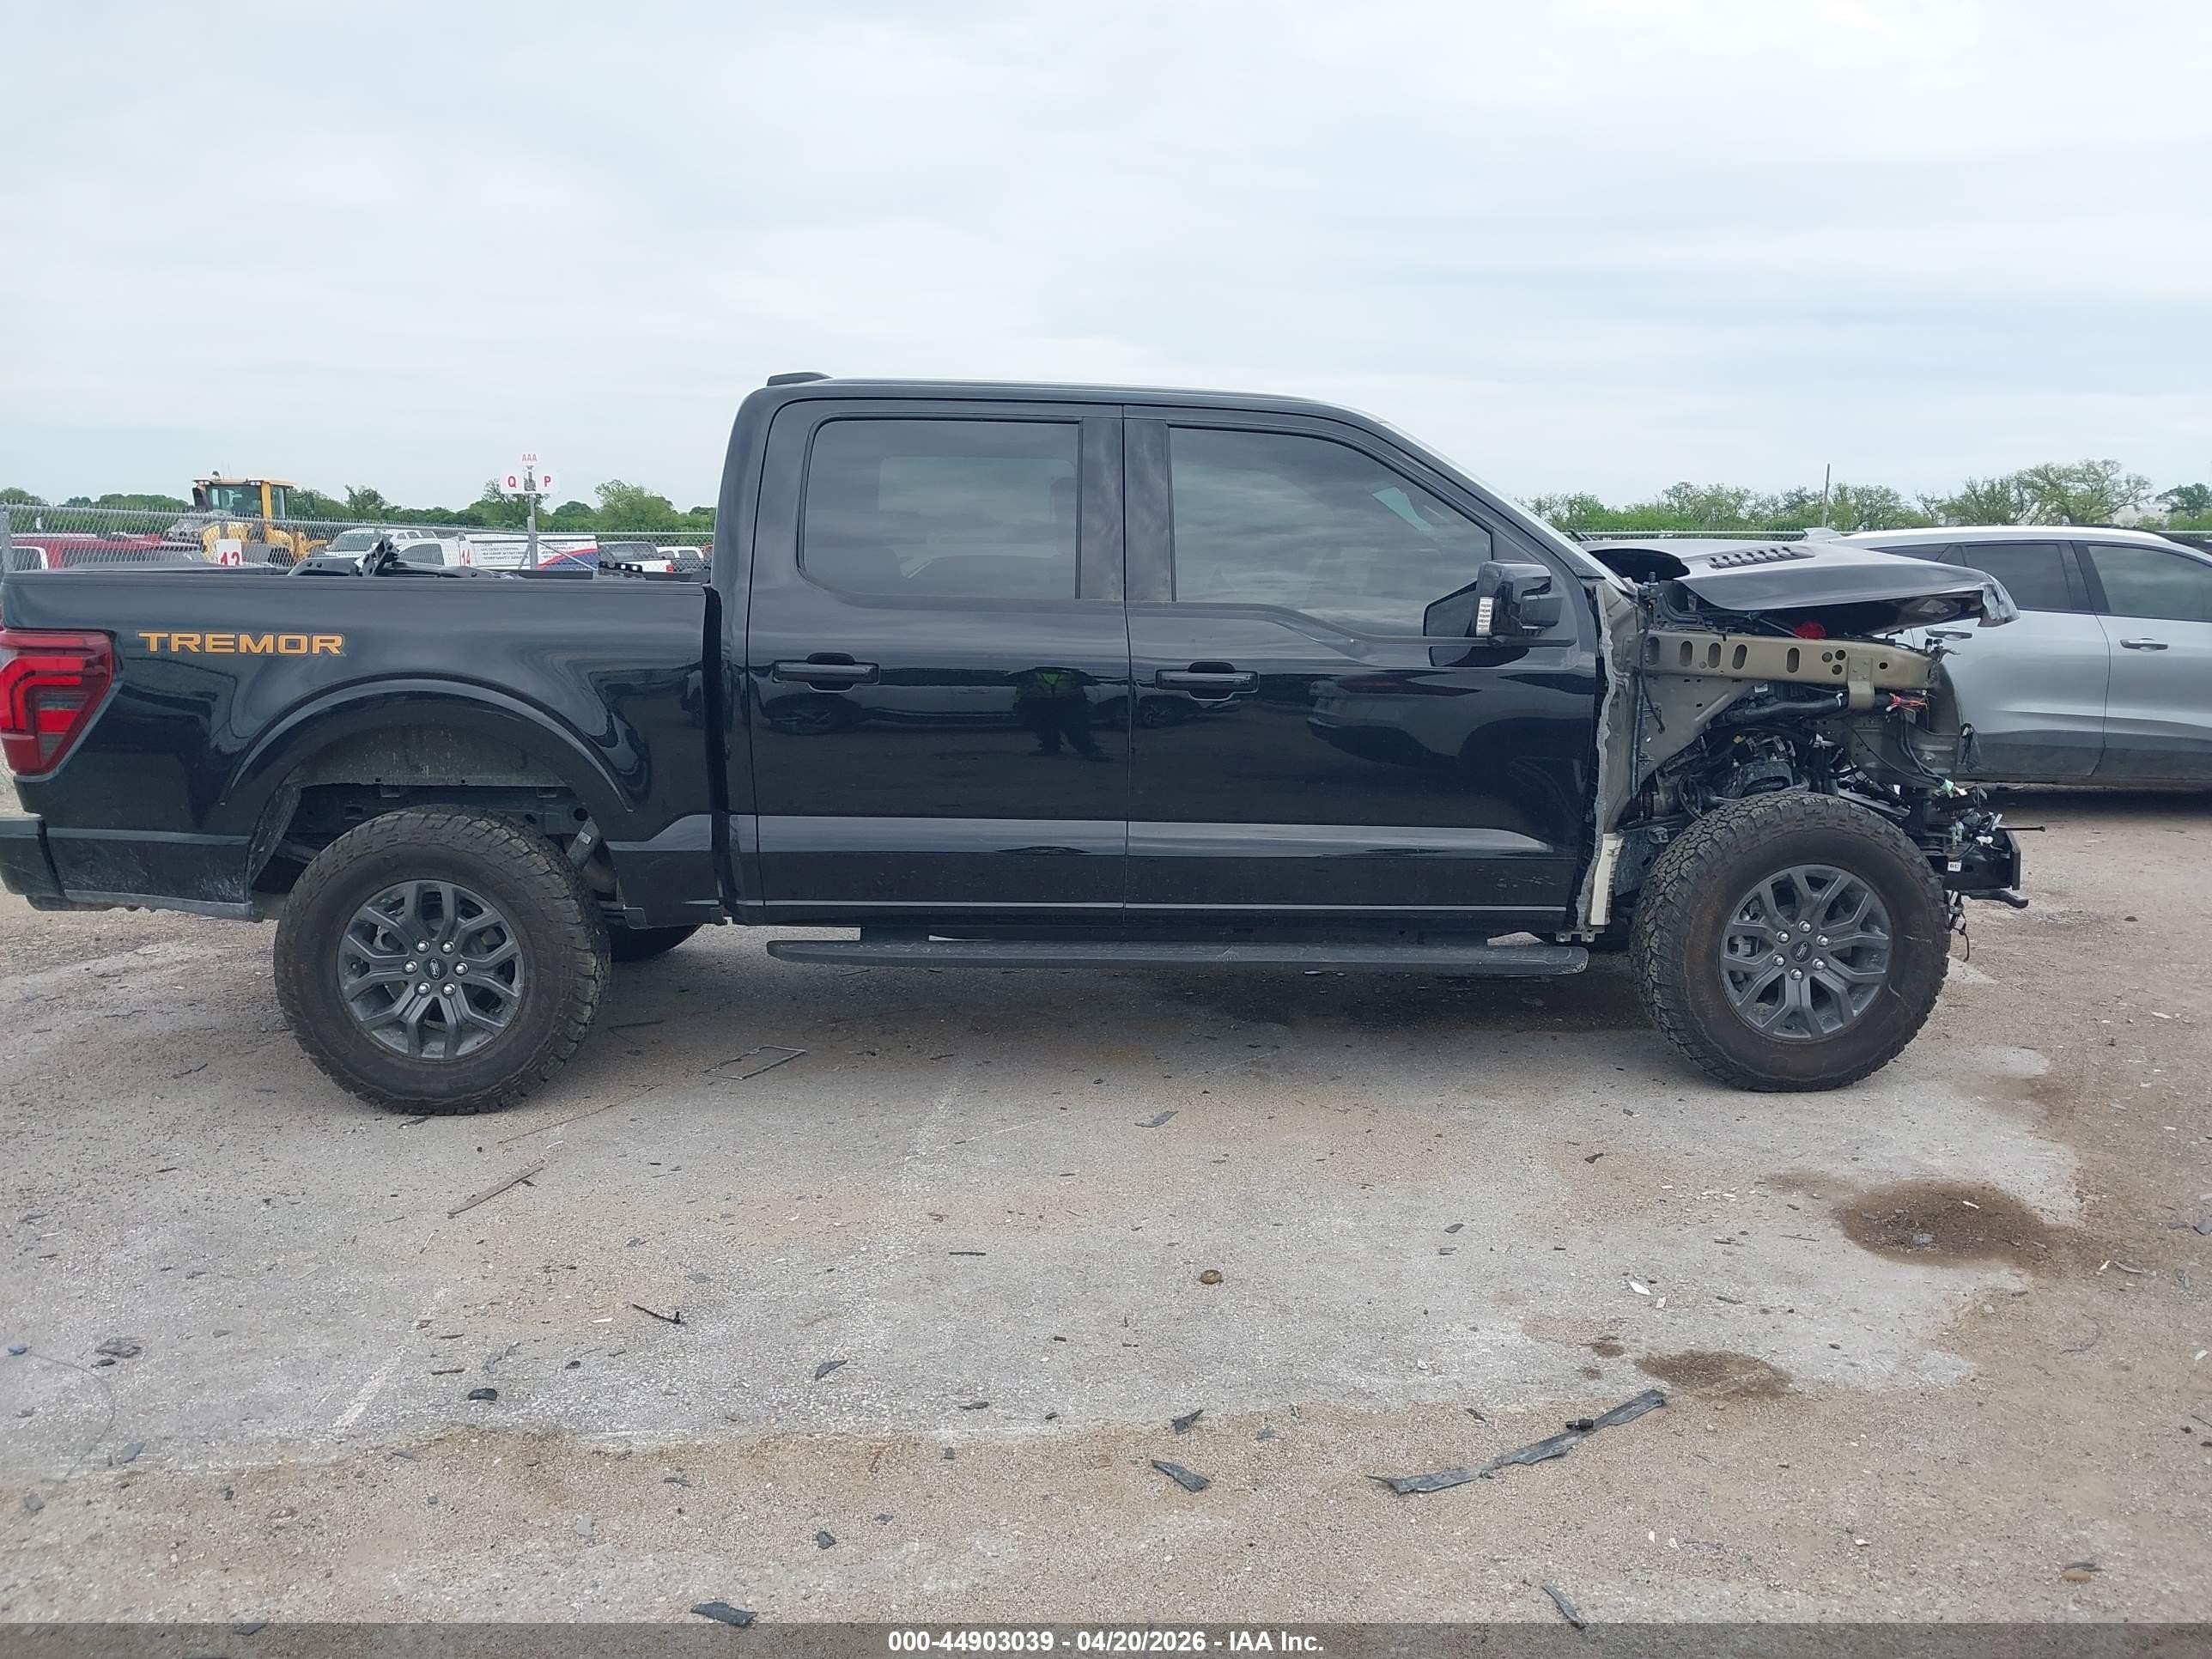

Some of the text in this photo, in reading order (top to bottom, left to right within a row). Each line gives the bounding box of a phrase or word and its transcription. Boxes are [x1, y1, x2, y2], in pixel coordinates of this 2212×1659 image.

[507, 476, 517, 488] Q
[544, 476, 551, 487] P
[137, 632, 343, 655] TREMOR
